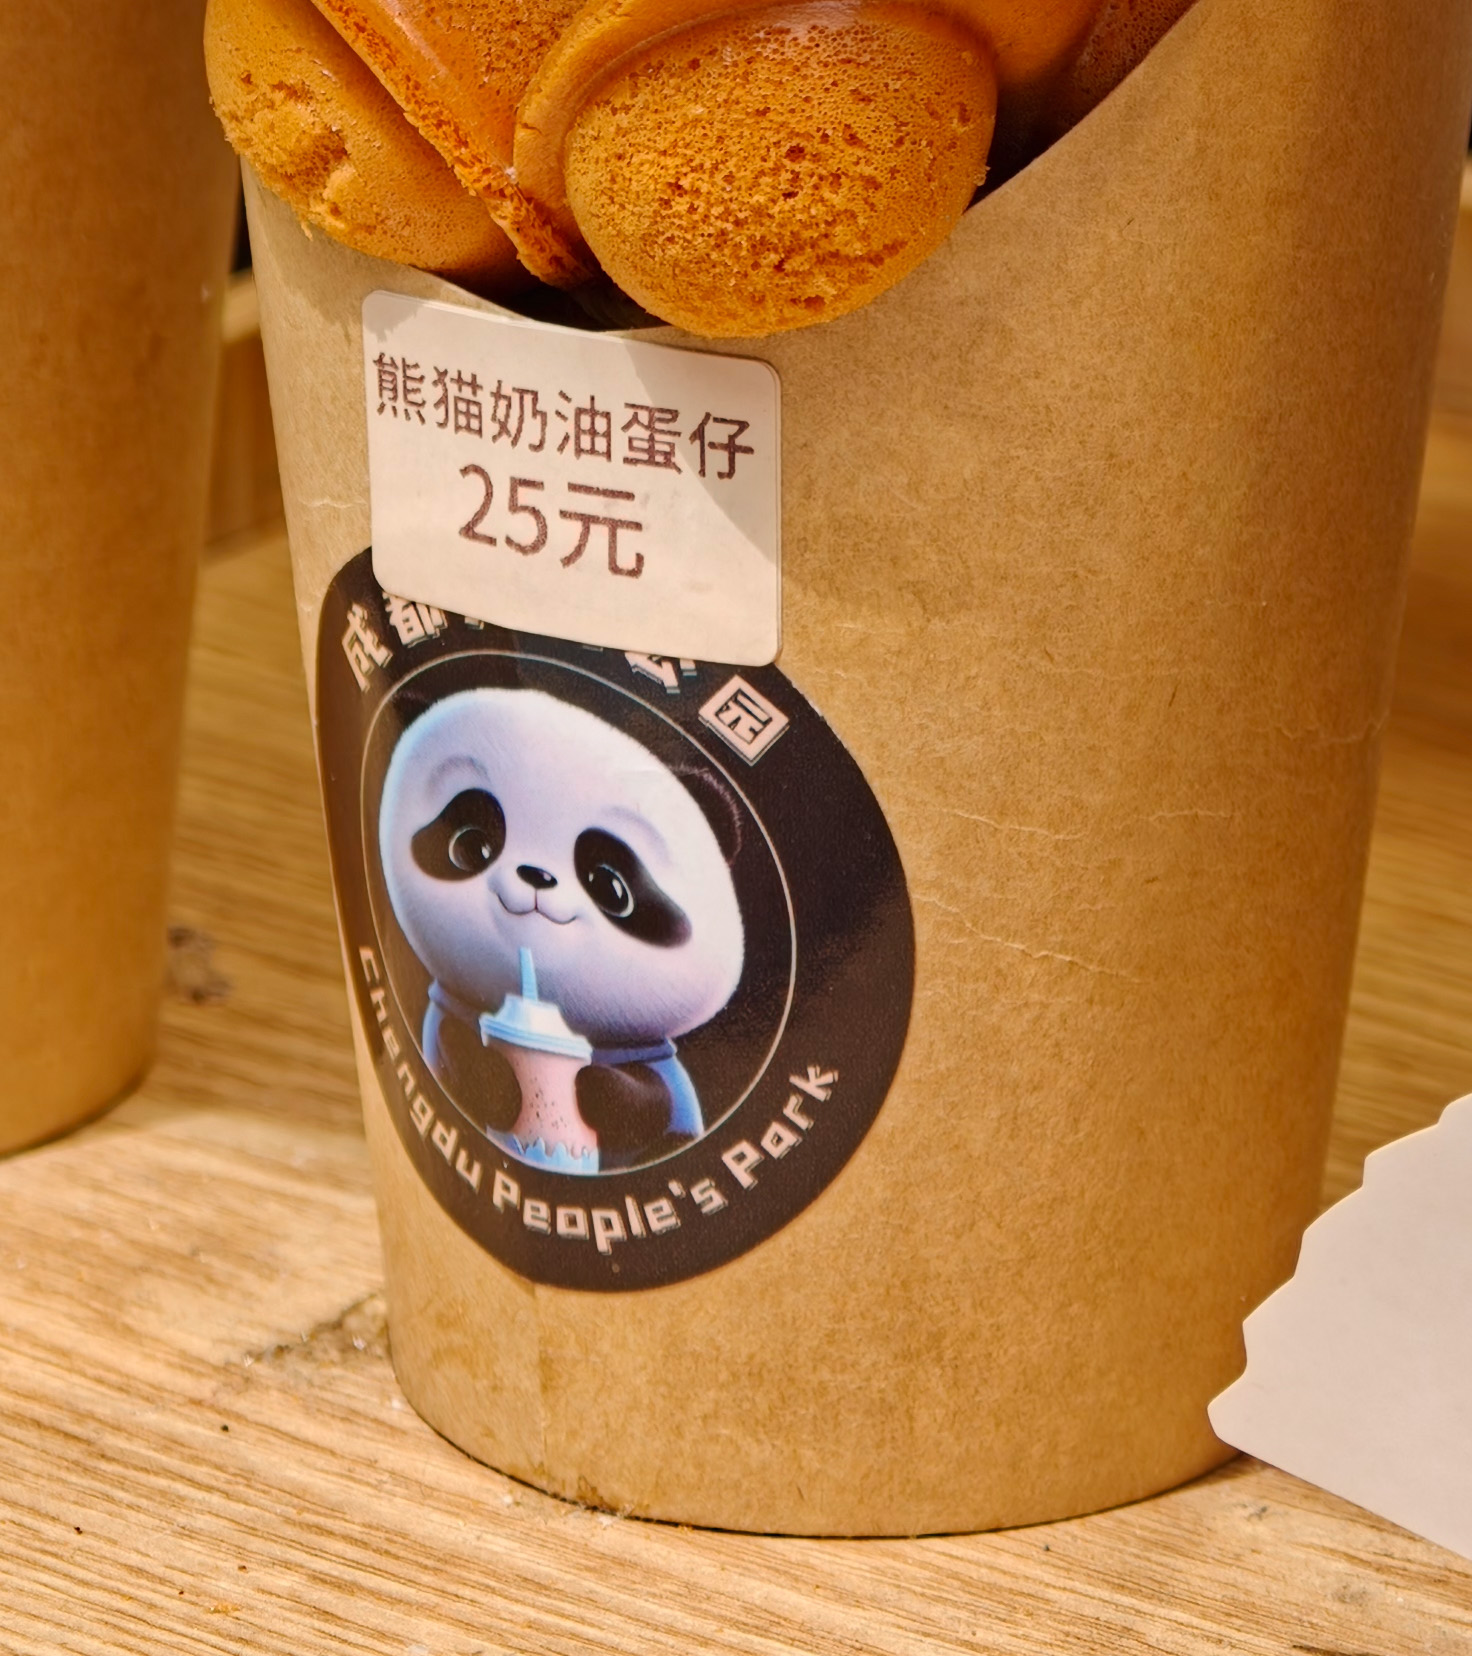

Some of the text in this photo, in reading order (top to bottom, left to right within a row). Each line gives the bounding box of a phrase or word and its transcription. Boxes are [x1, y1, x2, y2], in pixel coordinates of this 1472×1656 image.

[372, 351, 755, 481] 熊猫奶油蛋仔
[458, 463, 645, 580] 25元
[358, 945, 840, 1257] Chengdu People's Park
